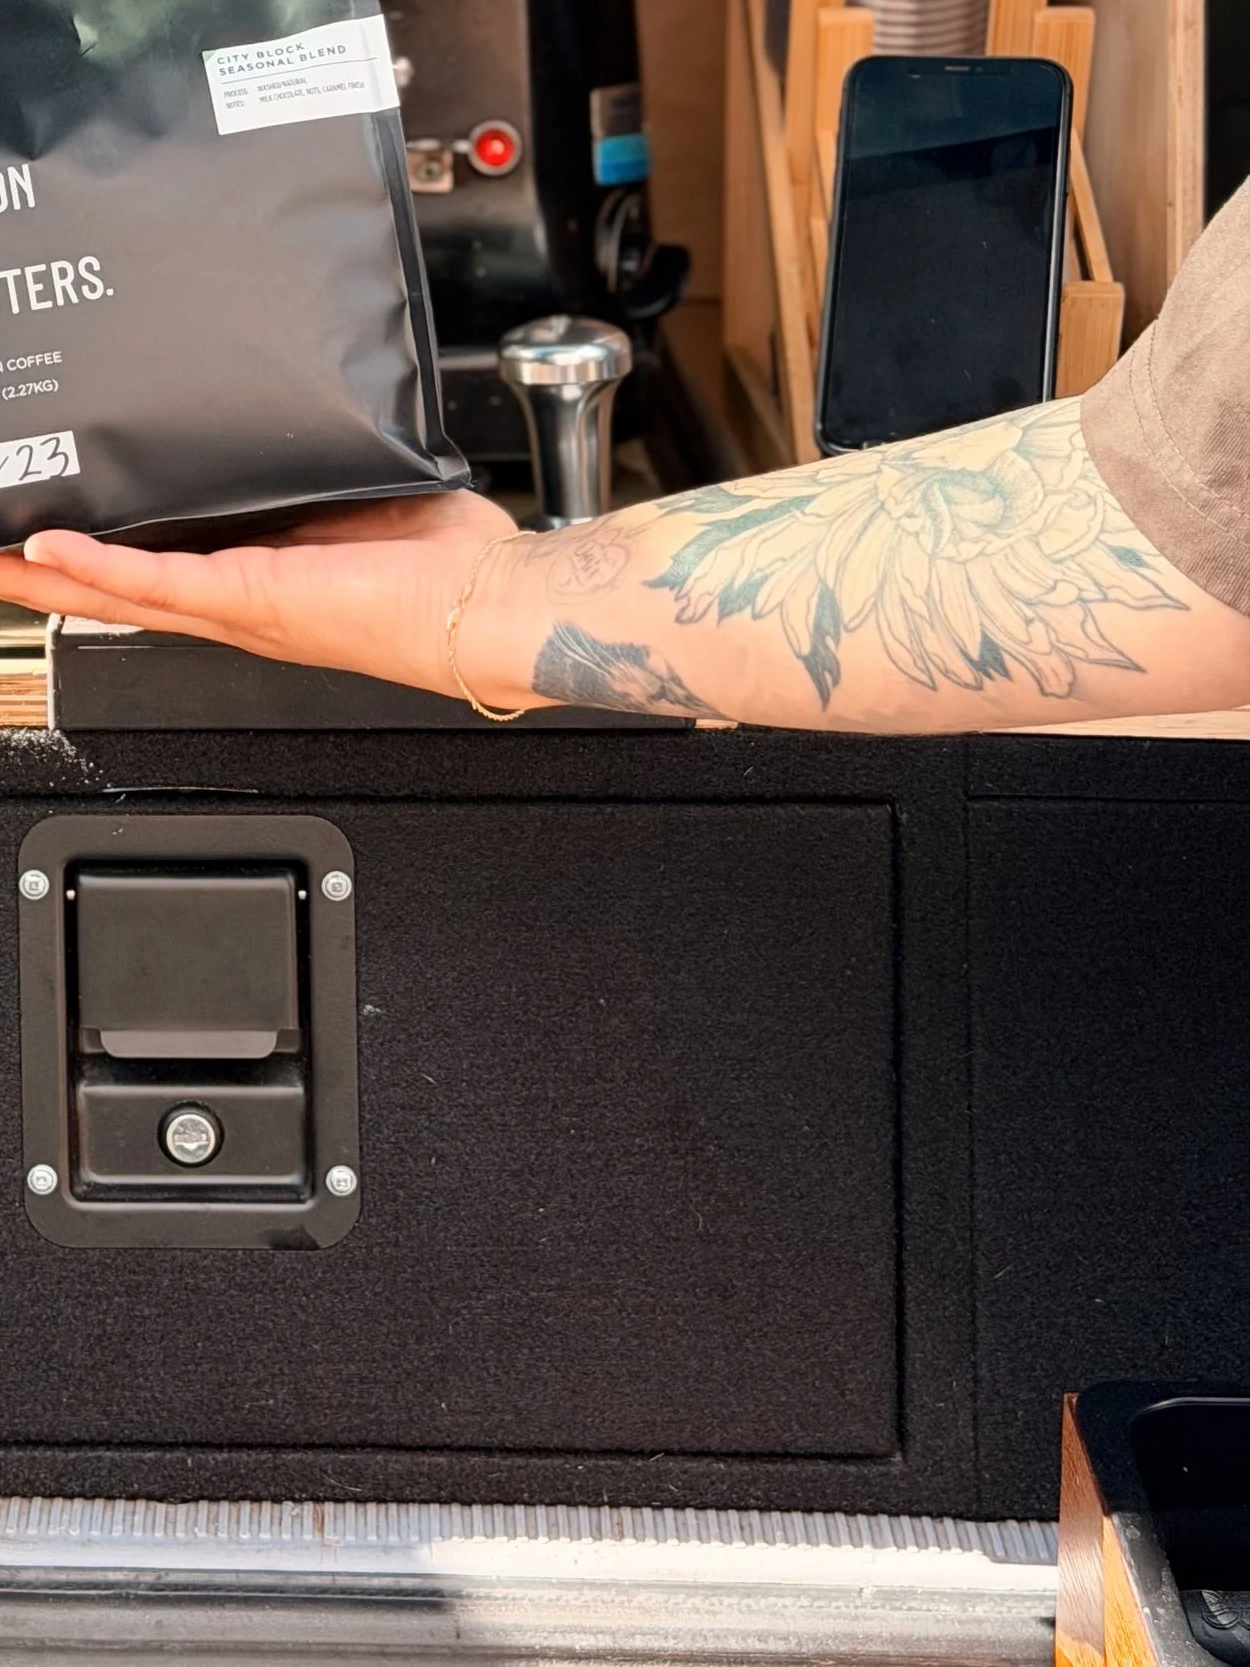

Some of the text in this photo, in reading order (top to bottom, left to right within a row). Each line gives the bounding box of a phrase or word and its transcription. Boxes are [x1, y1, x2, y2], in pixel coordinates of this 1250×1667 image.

[216, 42, 305, 65] CITY BLOCK
[219, 45, 347, 76] SEASONAL BLEND
[6, 351, 63, 372] COFFEE
[1, 378, 60, 401] (2.27KG)
